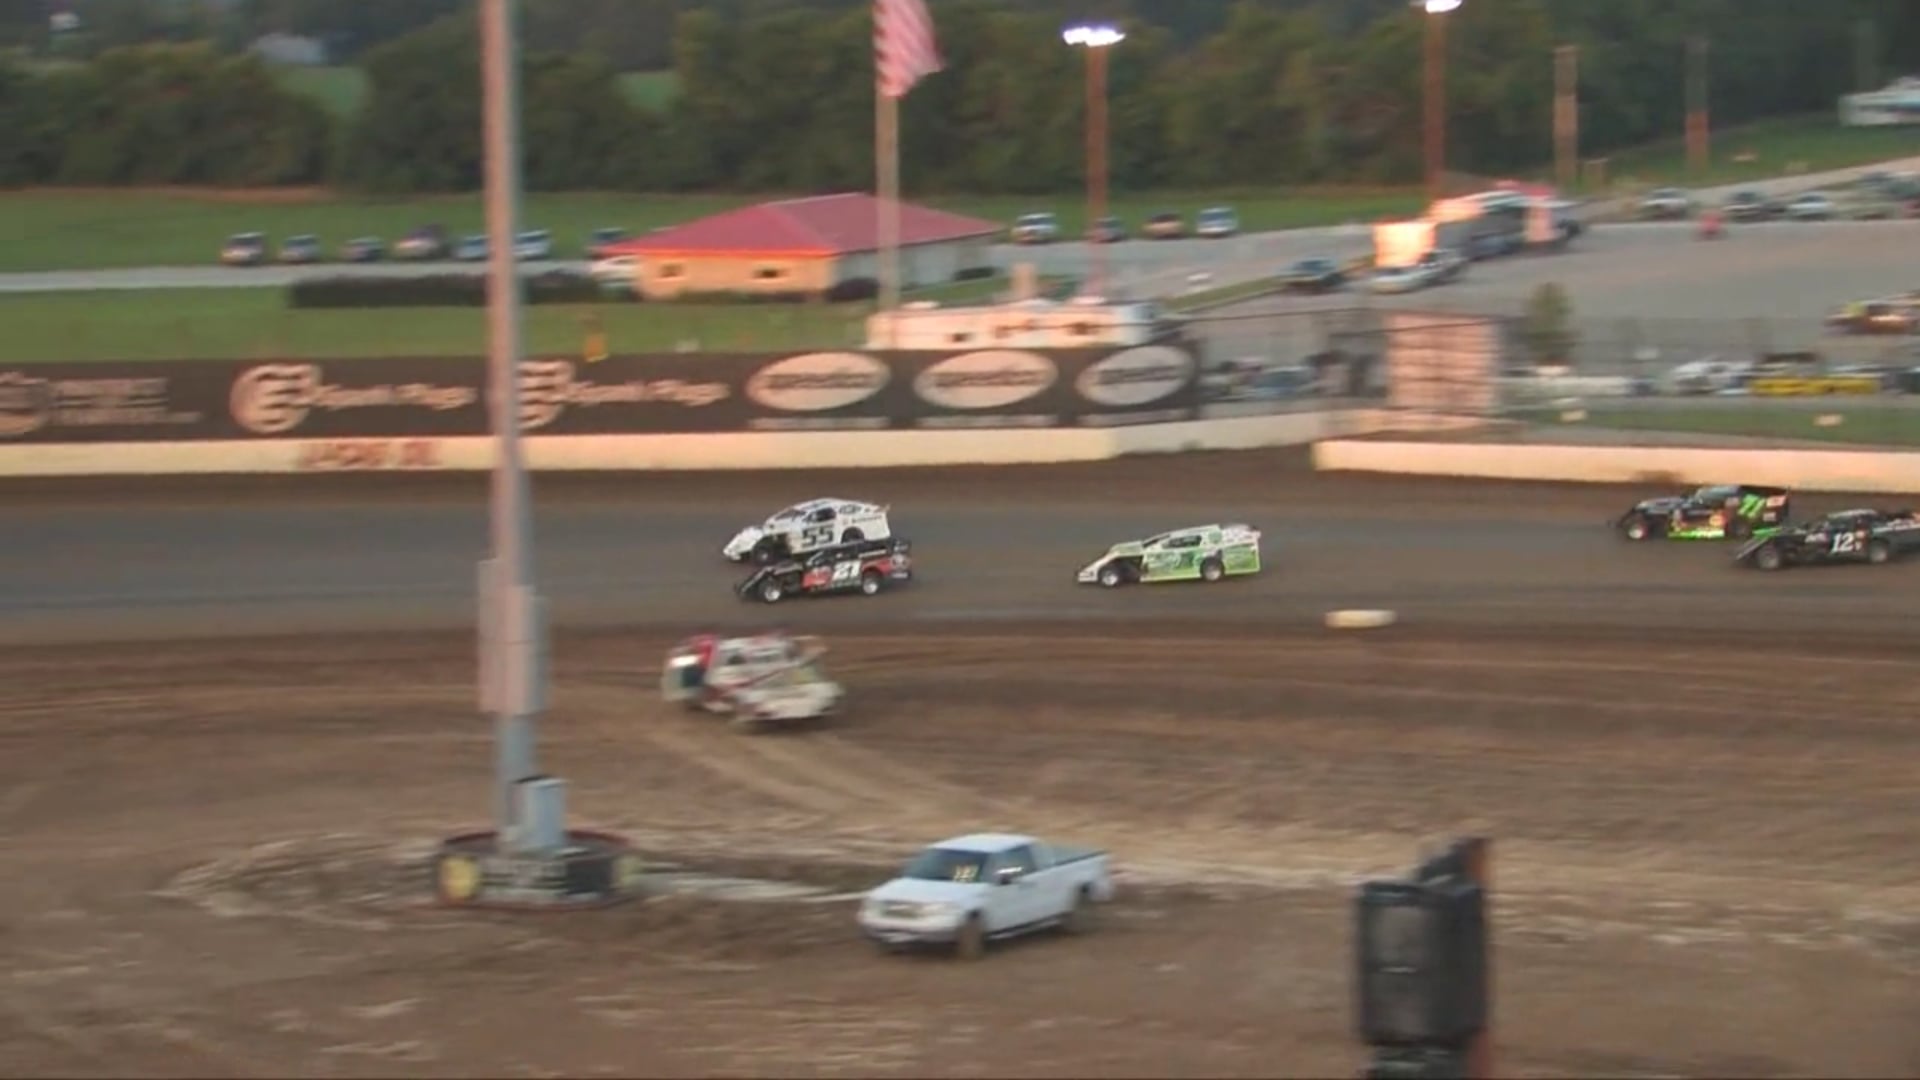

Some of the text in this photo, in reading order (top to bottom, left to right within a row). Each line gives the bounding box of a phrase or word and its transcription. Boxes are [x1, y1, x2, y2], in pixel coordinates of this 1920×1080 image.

[802, 526, 833, 547] 55
[1831, 533, 1854, 553] 12
[833, 560, 861, 579] 21
